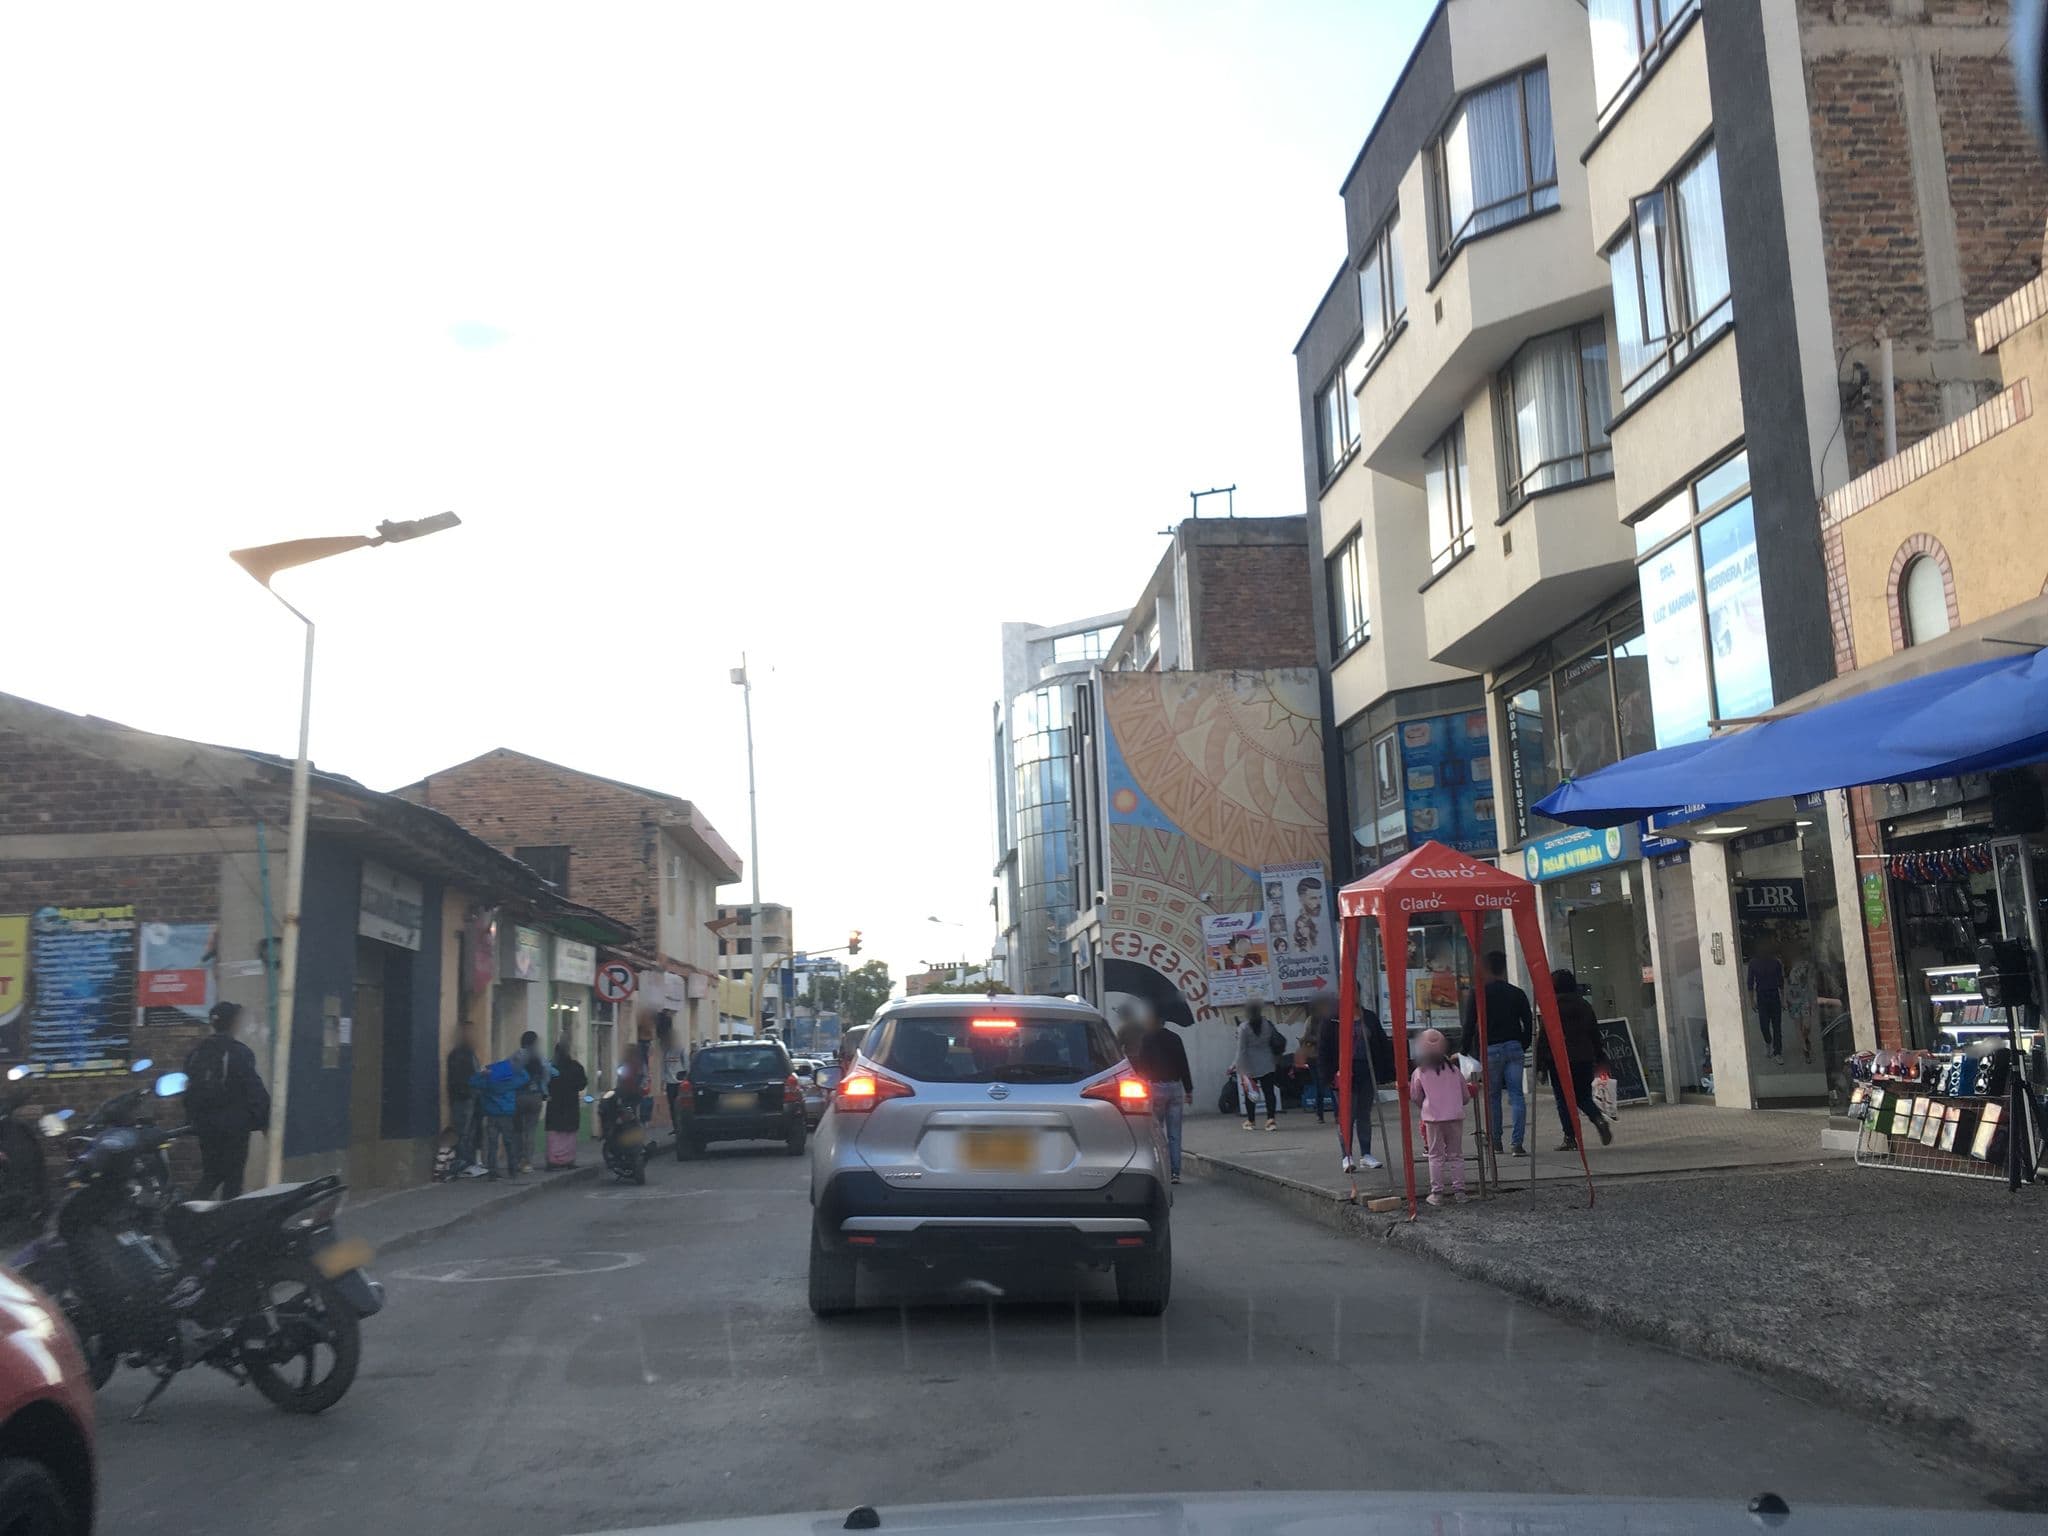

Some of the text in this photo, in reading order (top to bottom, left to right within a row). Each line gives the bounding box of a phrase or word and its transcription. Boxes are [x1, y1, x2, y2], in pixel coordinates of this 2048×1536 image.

[1653, 605, 1666, 624] LUZ
[1668, 588, 1697, 616] MARINA
[1512, 750, 1527, 838] EXCLUSIVA
[1410, 866, 1477, 878] Claro
[1400, 895, 1440, 911] Claro
[1475, 892, 1513, 906] Claro
[1746, 886, 1798, 907] LBR
